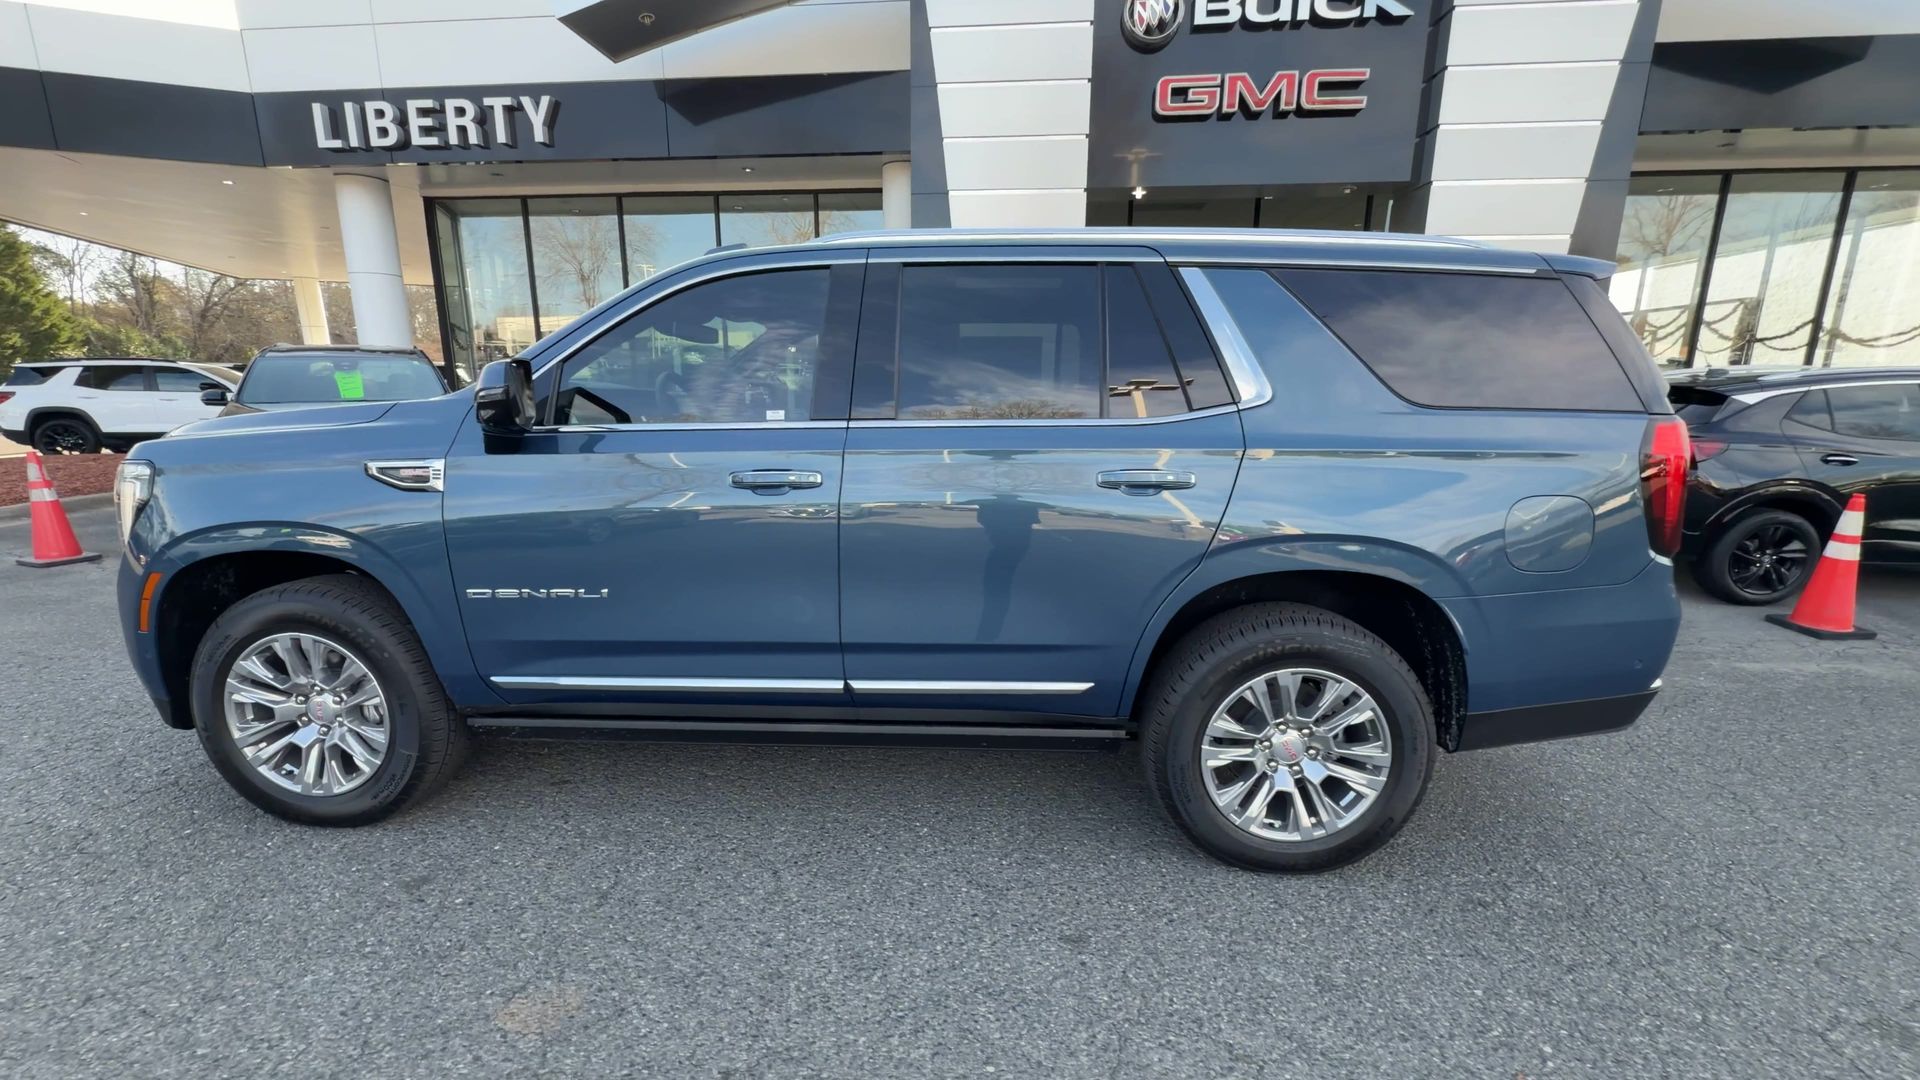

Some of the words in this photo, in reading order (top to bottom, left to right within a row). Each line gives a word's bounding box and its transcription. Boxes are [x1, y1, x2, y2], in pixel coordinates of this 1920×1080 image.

[1155, 68, 1370, 116] GMC
[311, 95, 556, 149] LIBERTY
[466, 588, 609, 599] DENALI
